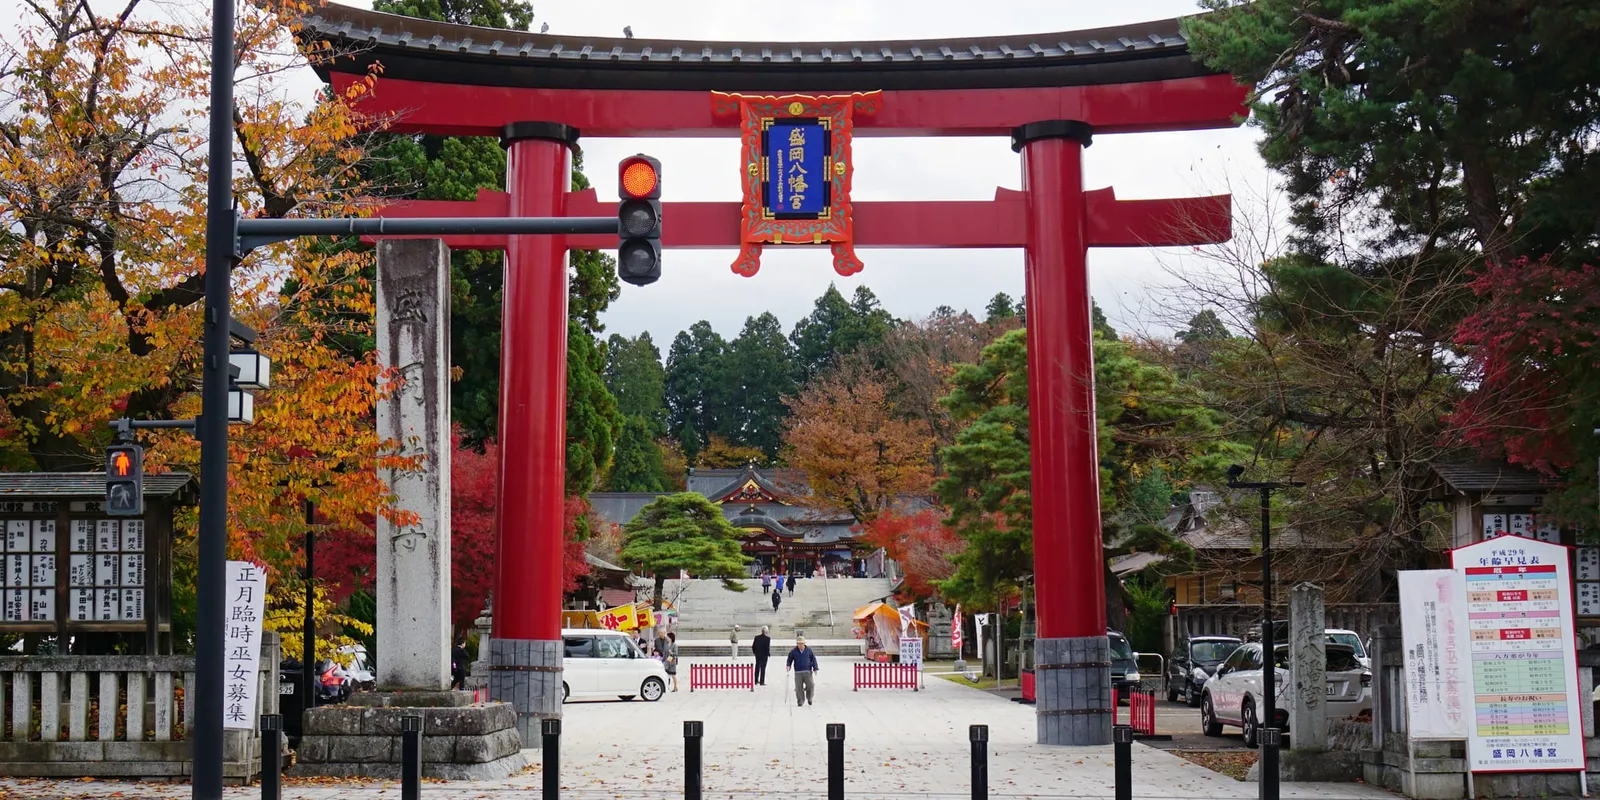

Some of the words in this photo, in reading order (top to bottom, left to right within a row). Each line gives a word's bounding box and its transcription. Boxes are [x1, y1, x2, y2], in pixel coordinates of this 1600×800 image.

[788, 127, 808, 210] 盛岡八幡宮
[1491, 549, 1526, 557] 平成29年
[1479, 556, 1540, 566] 年齢早見表
[226, 567, 259, 722] 正月臨時巫女募集
[1492, 748, 1557, 758] 盛岡八幡宮
